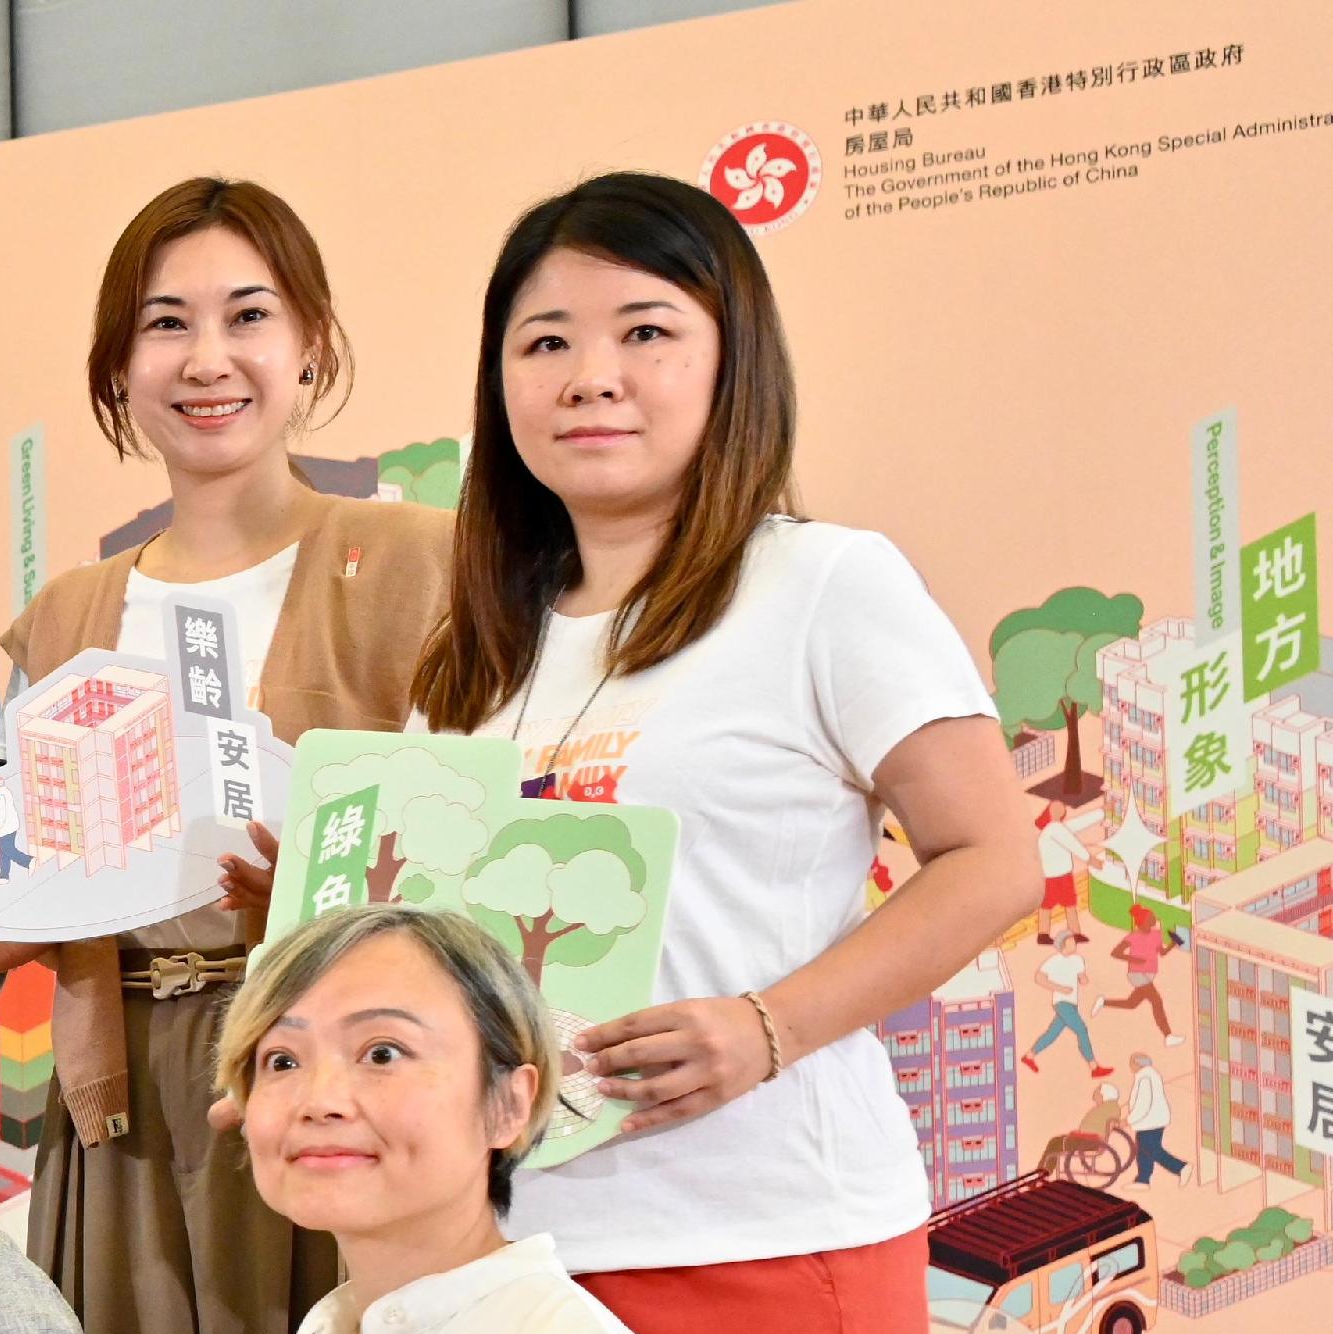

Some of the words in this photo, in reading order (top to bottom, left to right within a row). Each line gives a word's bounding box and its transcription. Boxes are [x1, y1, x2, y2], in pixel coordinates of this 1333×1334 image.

[844, 43, 1244, 127] 中華人民共和國香港特別行政區政府
[844, 127, 914, 156] 房屋局
[844, 157, 916, 178] Housing
[922, 147, 986, 167] Bureau
[844, 183, 876, 199] The
[881, 166, 988, 195] Government
[995, 159, 1011, 177] of
[1017, 157, 1045, 173] the
[1050, 148, 1099, 167] Hong
[1105, 141, 1152, 158] Kong
[1157, 127, 1226, 152] Special
[844, 204, 861, 220] of
[866, 201, 893, 216] the
[898, 187, 974, 211] People's
[979, 176, 1058, 200] Republic
[1063, 170, 1080, 187] of
[1085, 162, 1139, 184] China
[21, 438, 33, 496] Green
[1206, 420, 1225, 542] Perception
[1209, 543, 1225, 560] &
[1210, 560, 1226, 630] Image
[1252, 536, 1307, 682] 地方
[183, 616, 222, 709] 樂齡
[1180, 650, 1232, 794] 形象
[217, 729, 255, 821] 安居
[312, 804, 367, 916] 綠色
